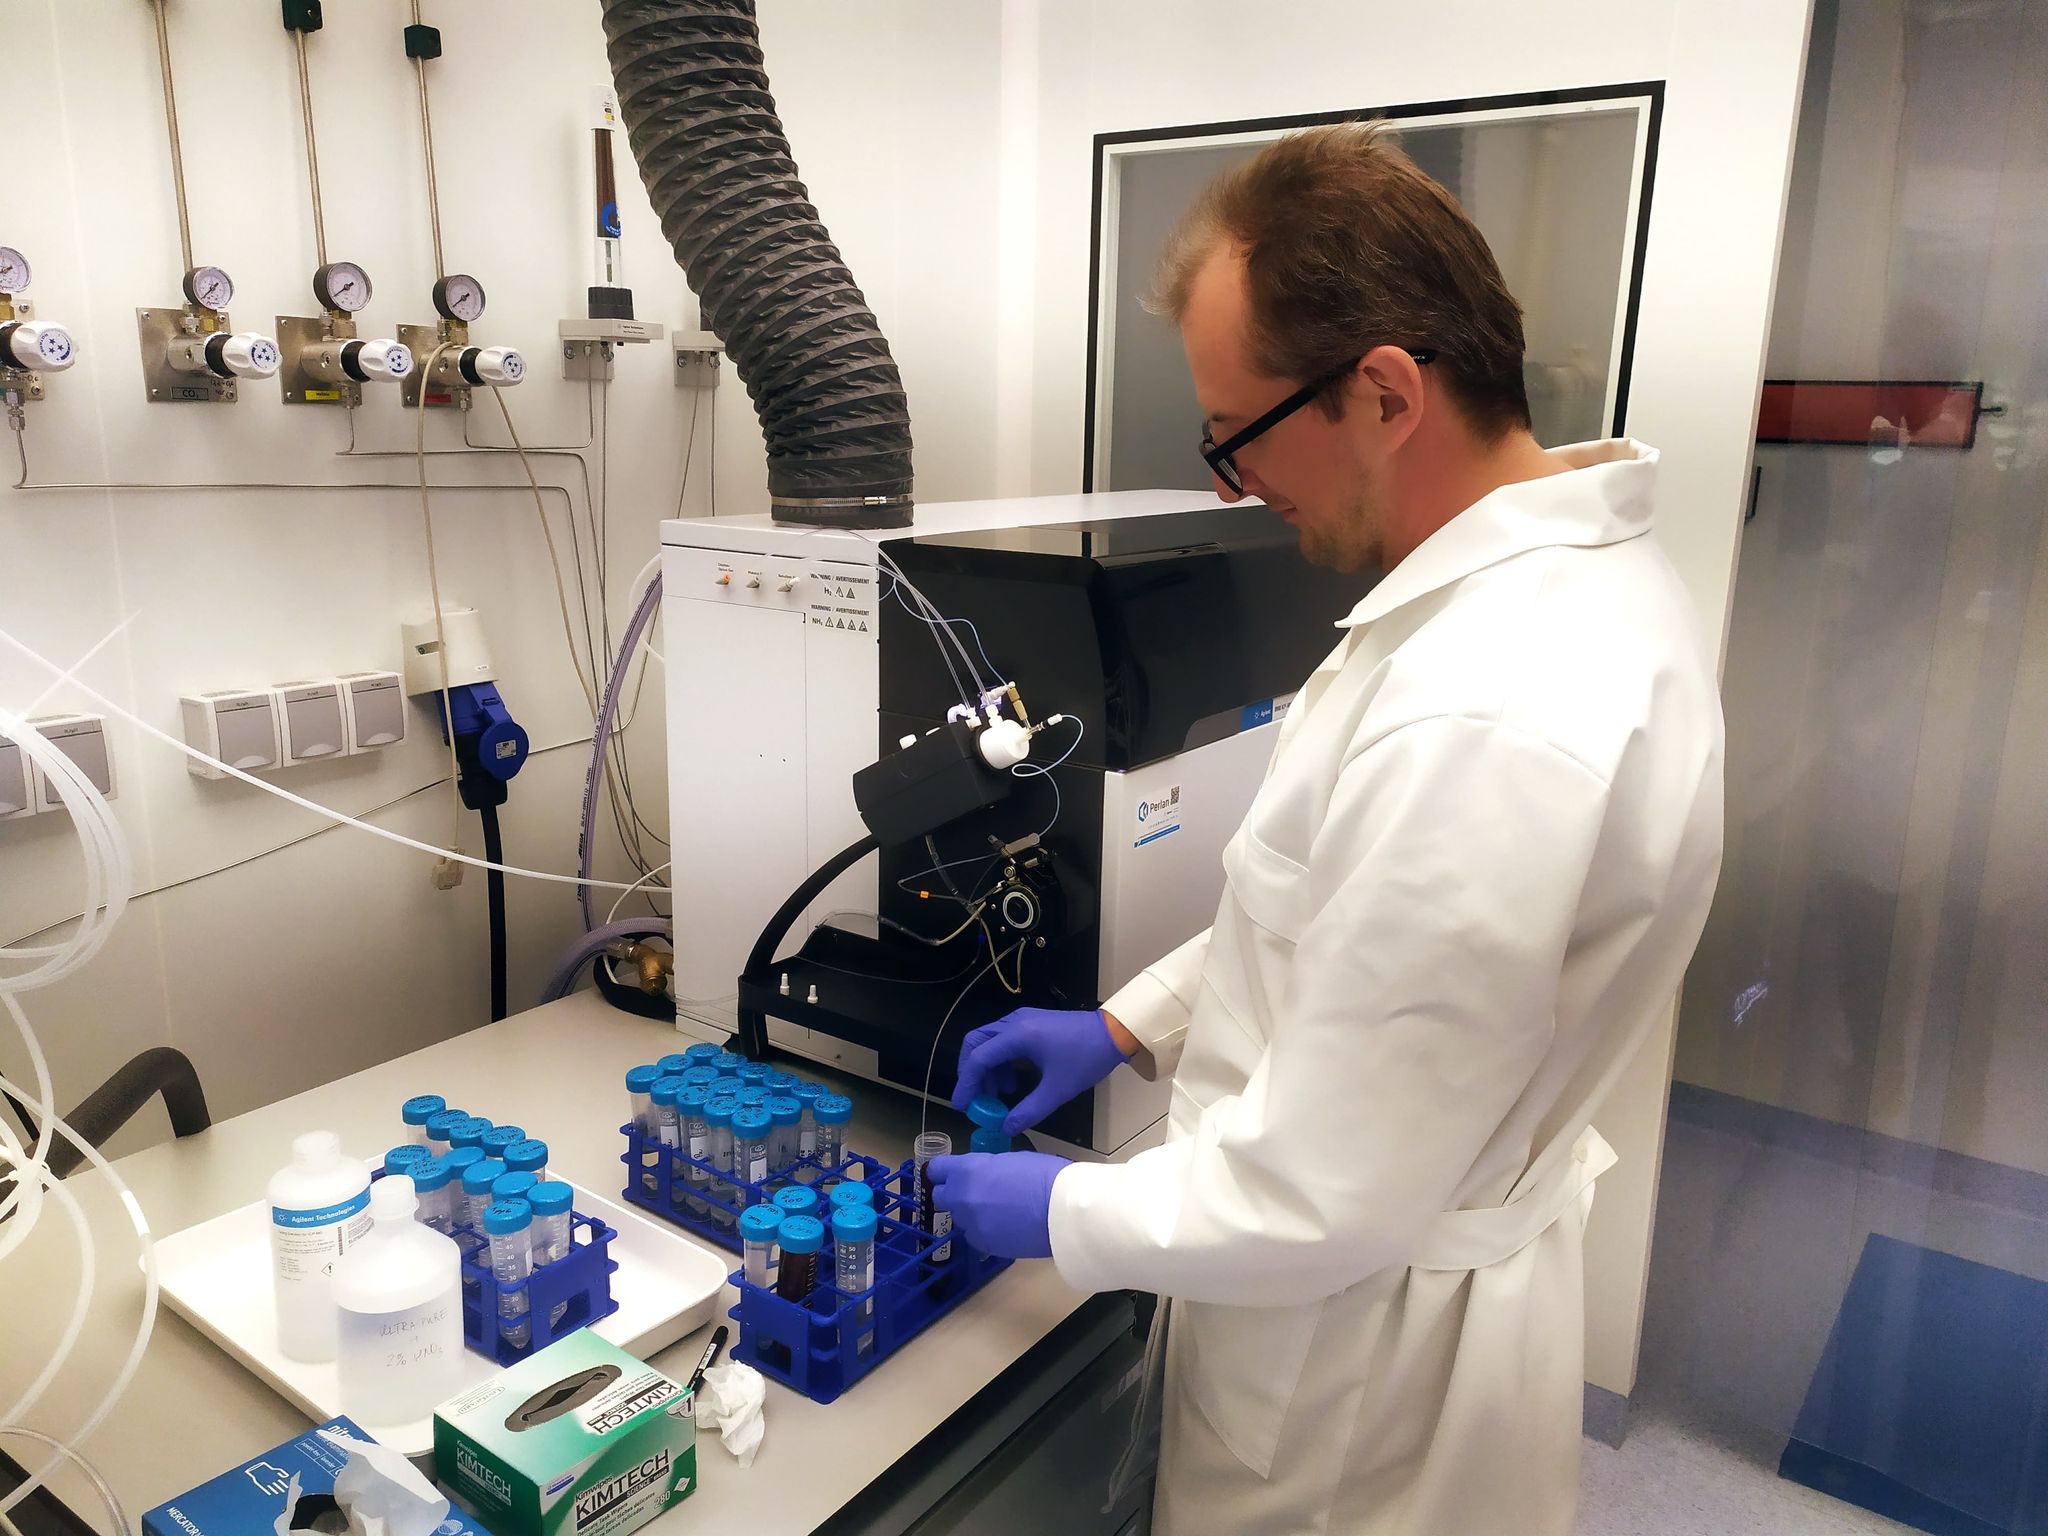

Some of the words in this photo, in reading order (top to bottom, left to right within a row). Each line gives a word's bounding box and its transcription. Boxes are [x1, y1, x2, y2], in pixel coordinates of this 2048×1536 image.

[835, 575, 870, 585] AVERTISSEMENT
[811, 604, 831, 612] WARNING
[835, 607, 870, 616] AVERTISSEMENT
[1150, 799, 1170, 813] Perlan
[291, 1215, 314, 1223] Agilent
[315, 1205, 356, 1221] Technologies
[381, 1321, 415, 1336] ULTRA
[593, 1383, 677, 1433] KIMTECH
[651, 1389, 684, 1408] Kimwipes
[686, 1397, 692, 1412] 1
[457, 1447, 511, 1498] KIMTECH
[576, 1449, 669, 1521] KIMTECH
[576, 1474, 613, 1501] Kimwipes
[626, 1479, 651, 1498] SCIENCE
[654, 1490, 671, 1509] 280
